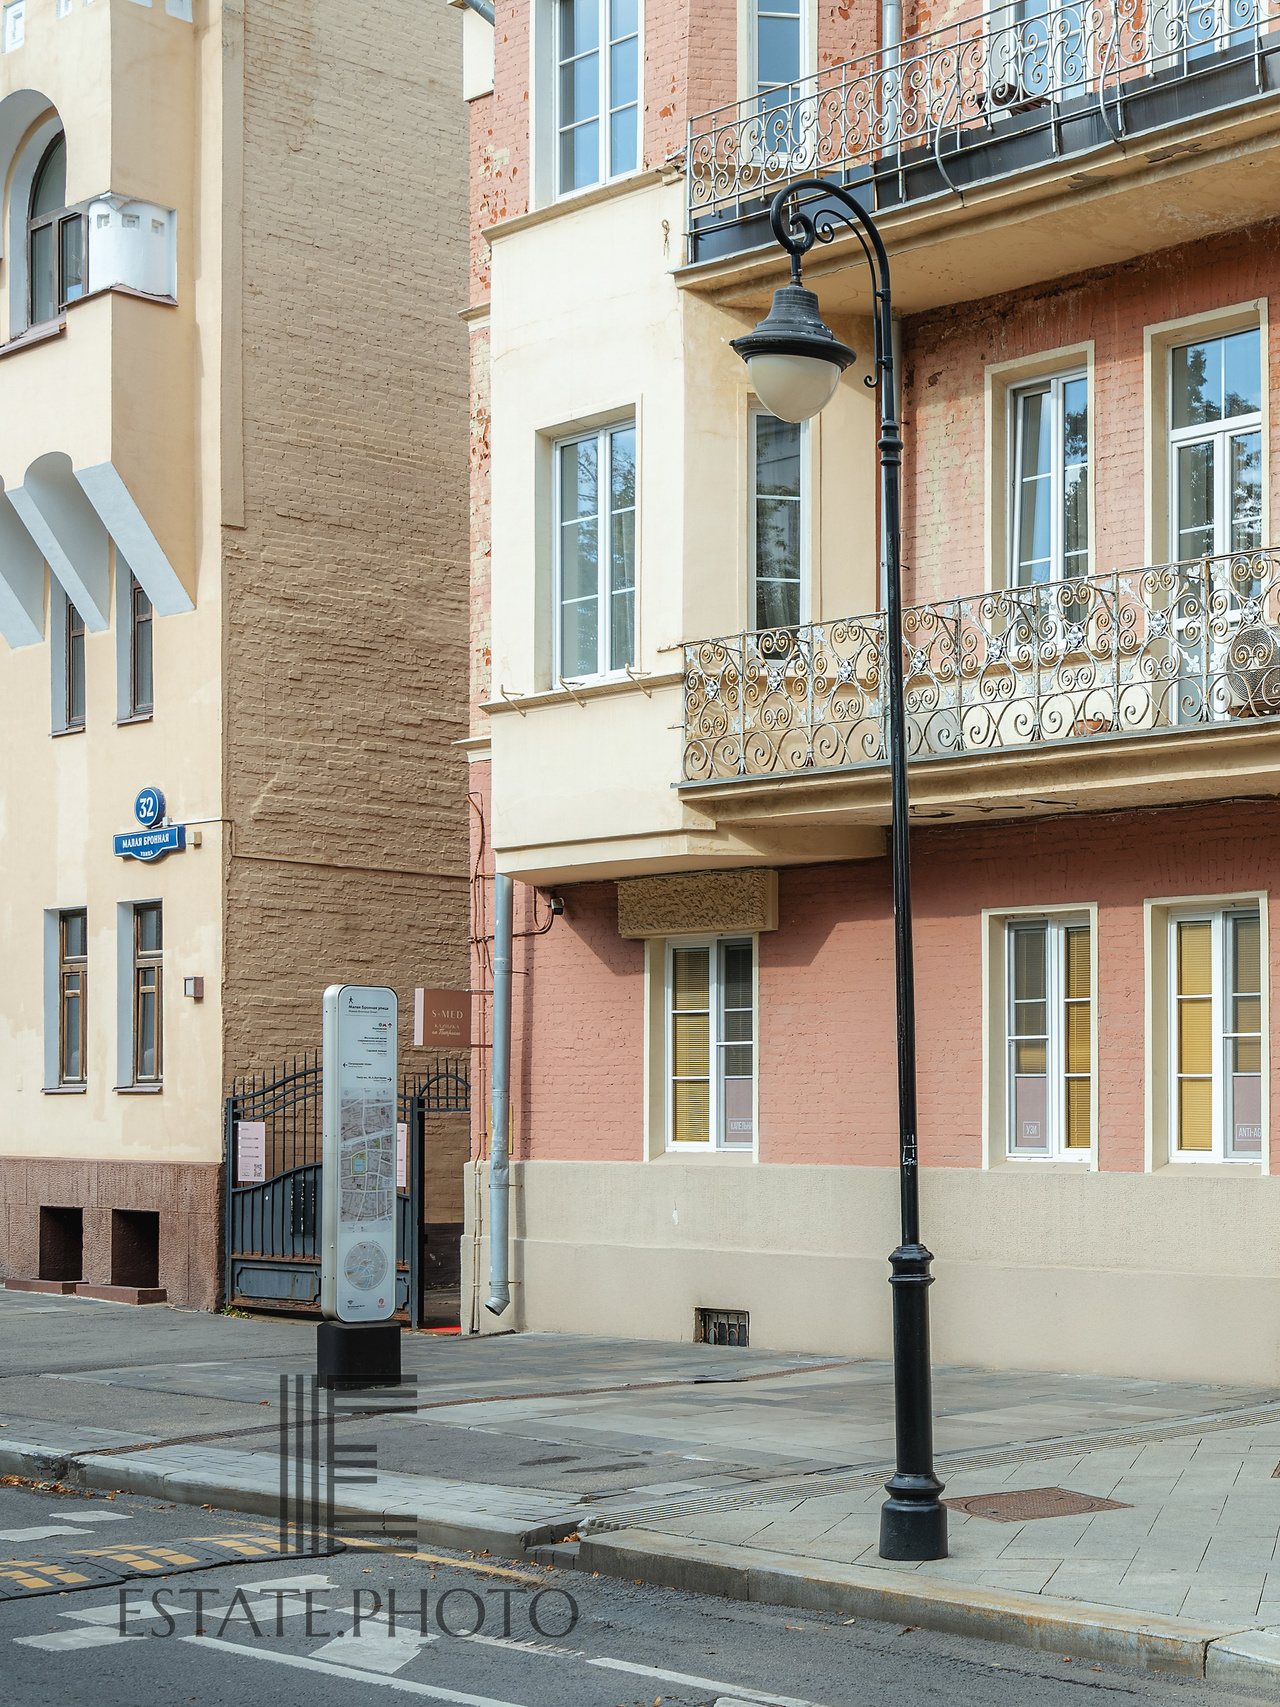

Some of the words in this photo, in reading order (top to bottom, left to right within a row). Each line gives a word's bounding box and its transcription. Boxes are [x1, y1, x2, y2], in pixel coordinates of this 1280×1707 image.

[139, 796, 154, 818] 32
[122, 837, 142, 849] МАЛАЯ
[143, 833, 170, 845] БРОННАЯ
[431, 1009, 464, 1019] S-MED
